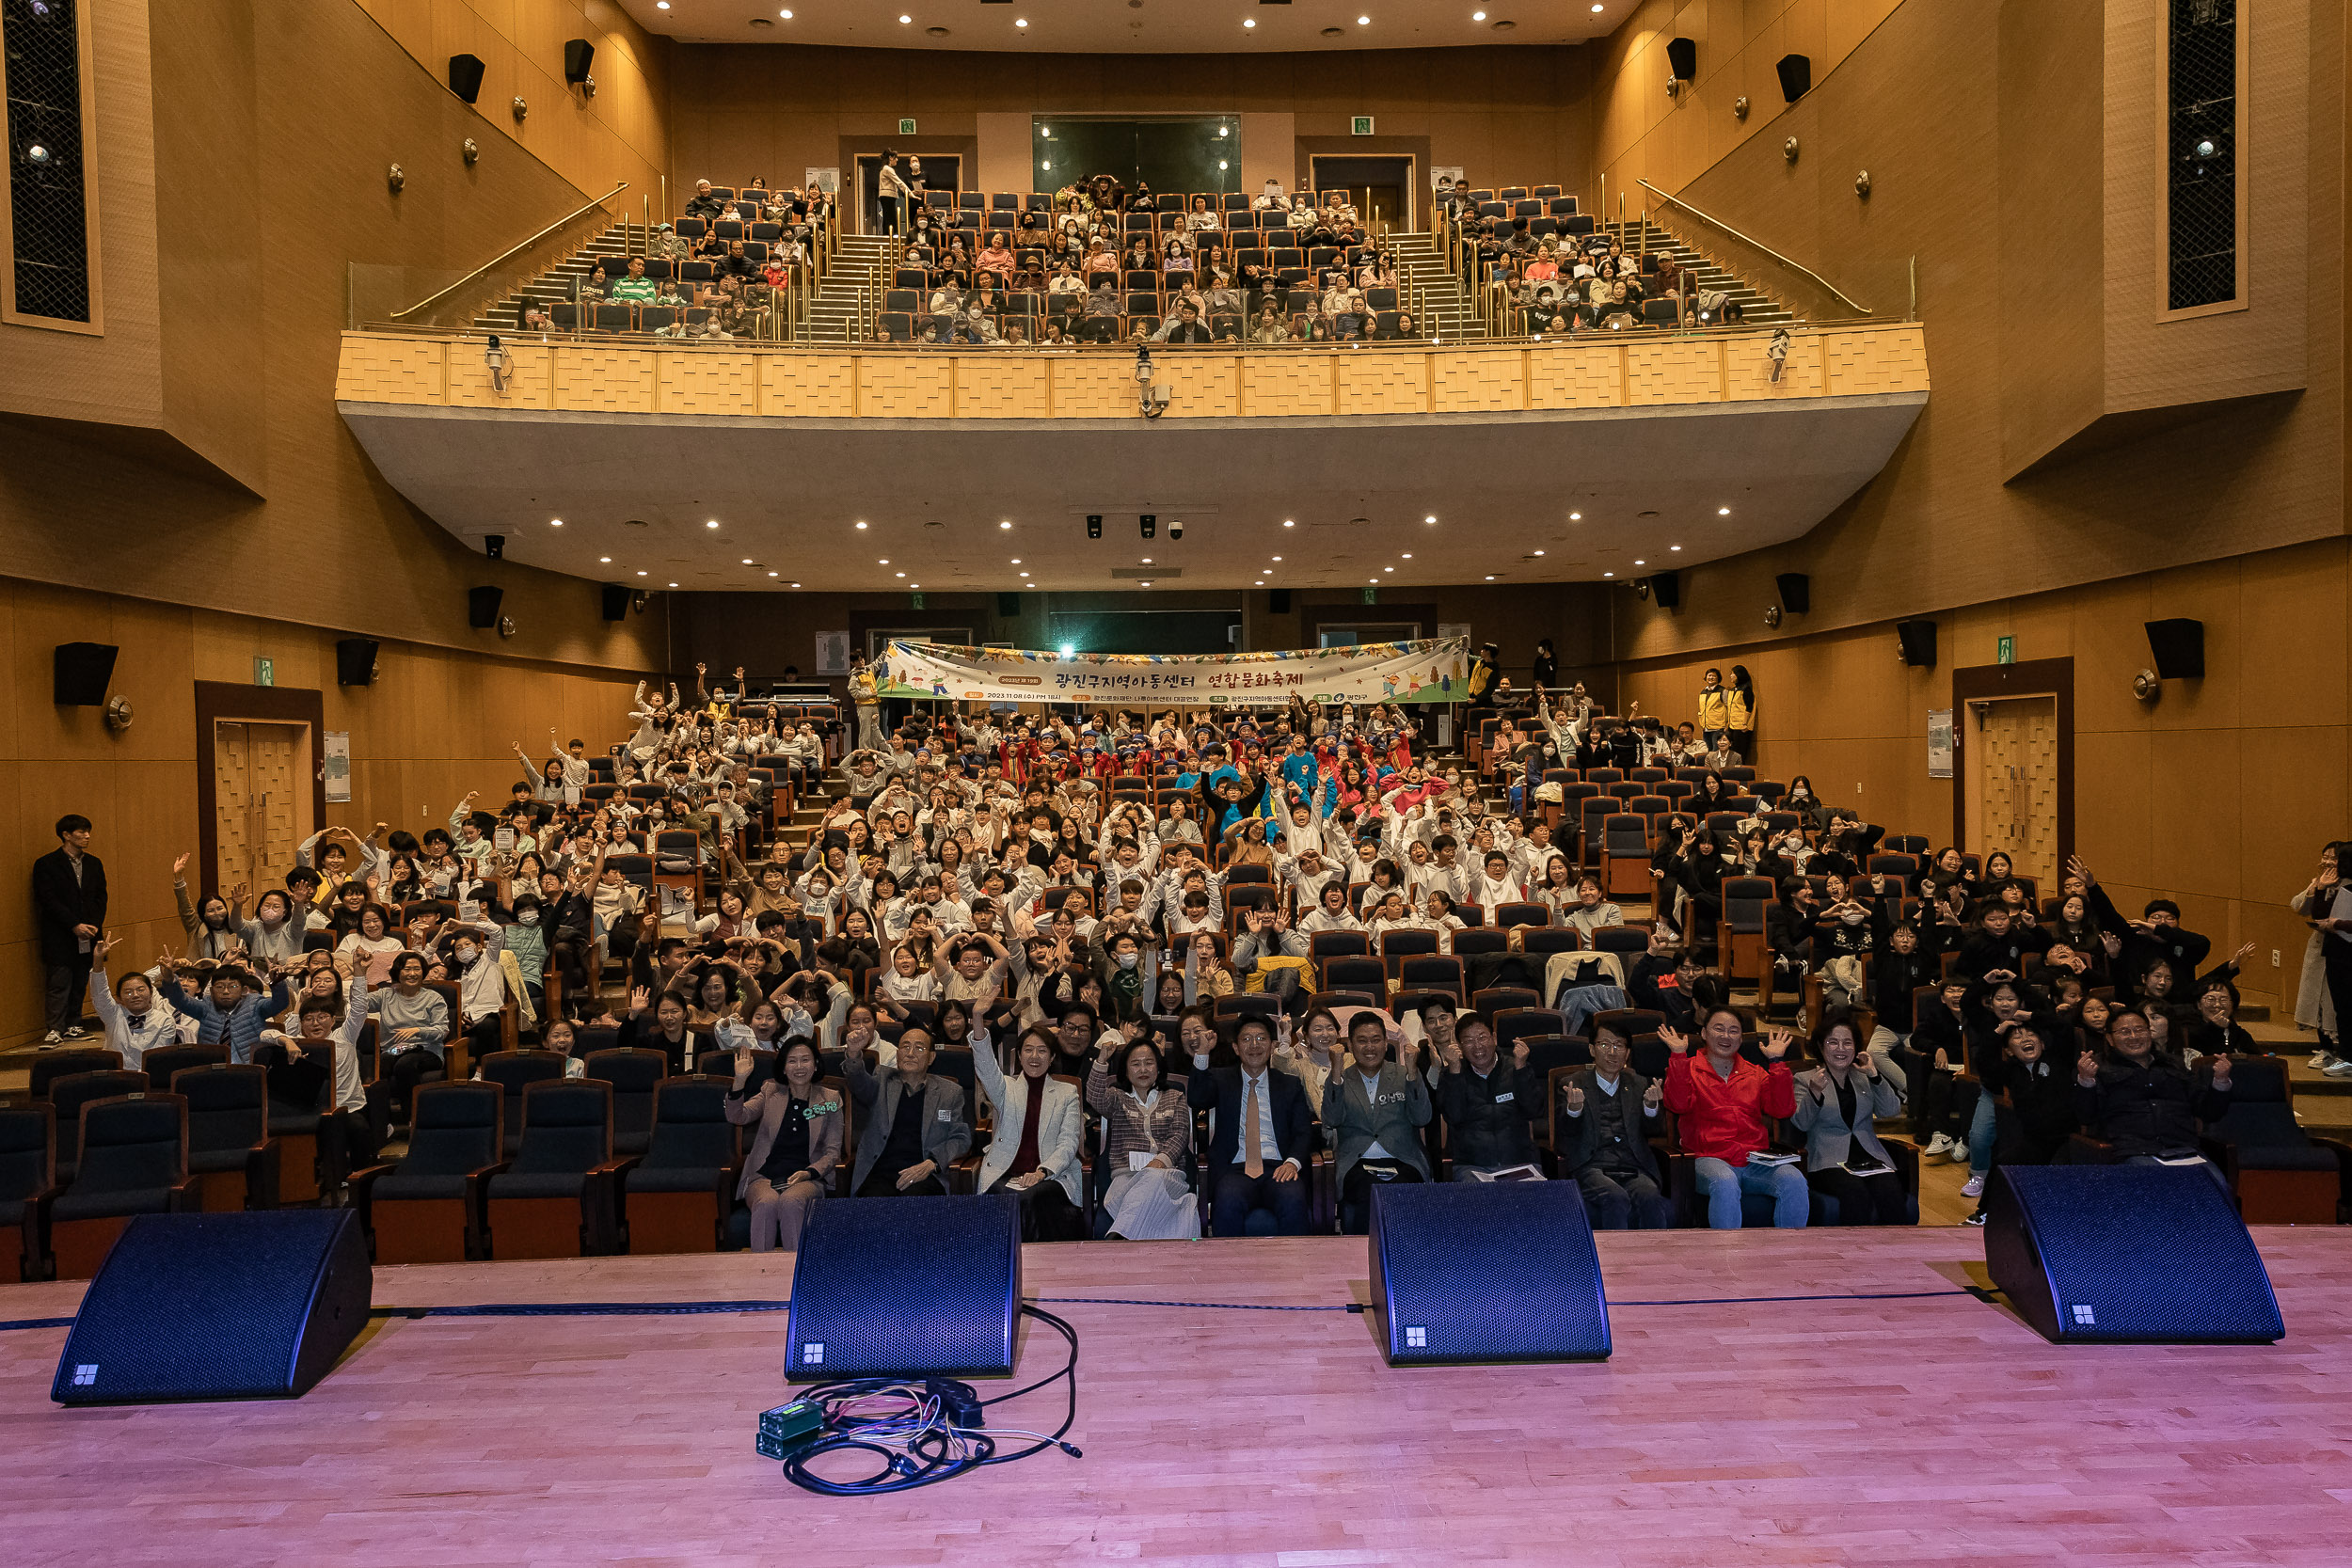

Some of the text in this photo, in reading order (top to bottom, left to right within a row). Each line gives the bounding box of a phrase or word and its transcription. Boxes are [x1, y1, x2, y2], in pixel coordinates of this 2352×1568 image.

[581, 285, 604, 294] LOUIS
[1055, 671, 1303, 689] 광진구지역아동센터 연합문화축제
